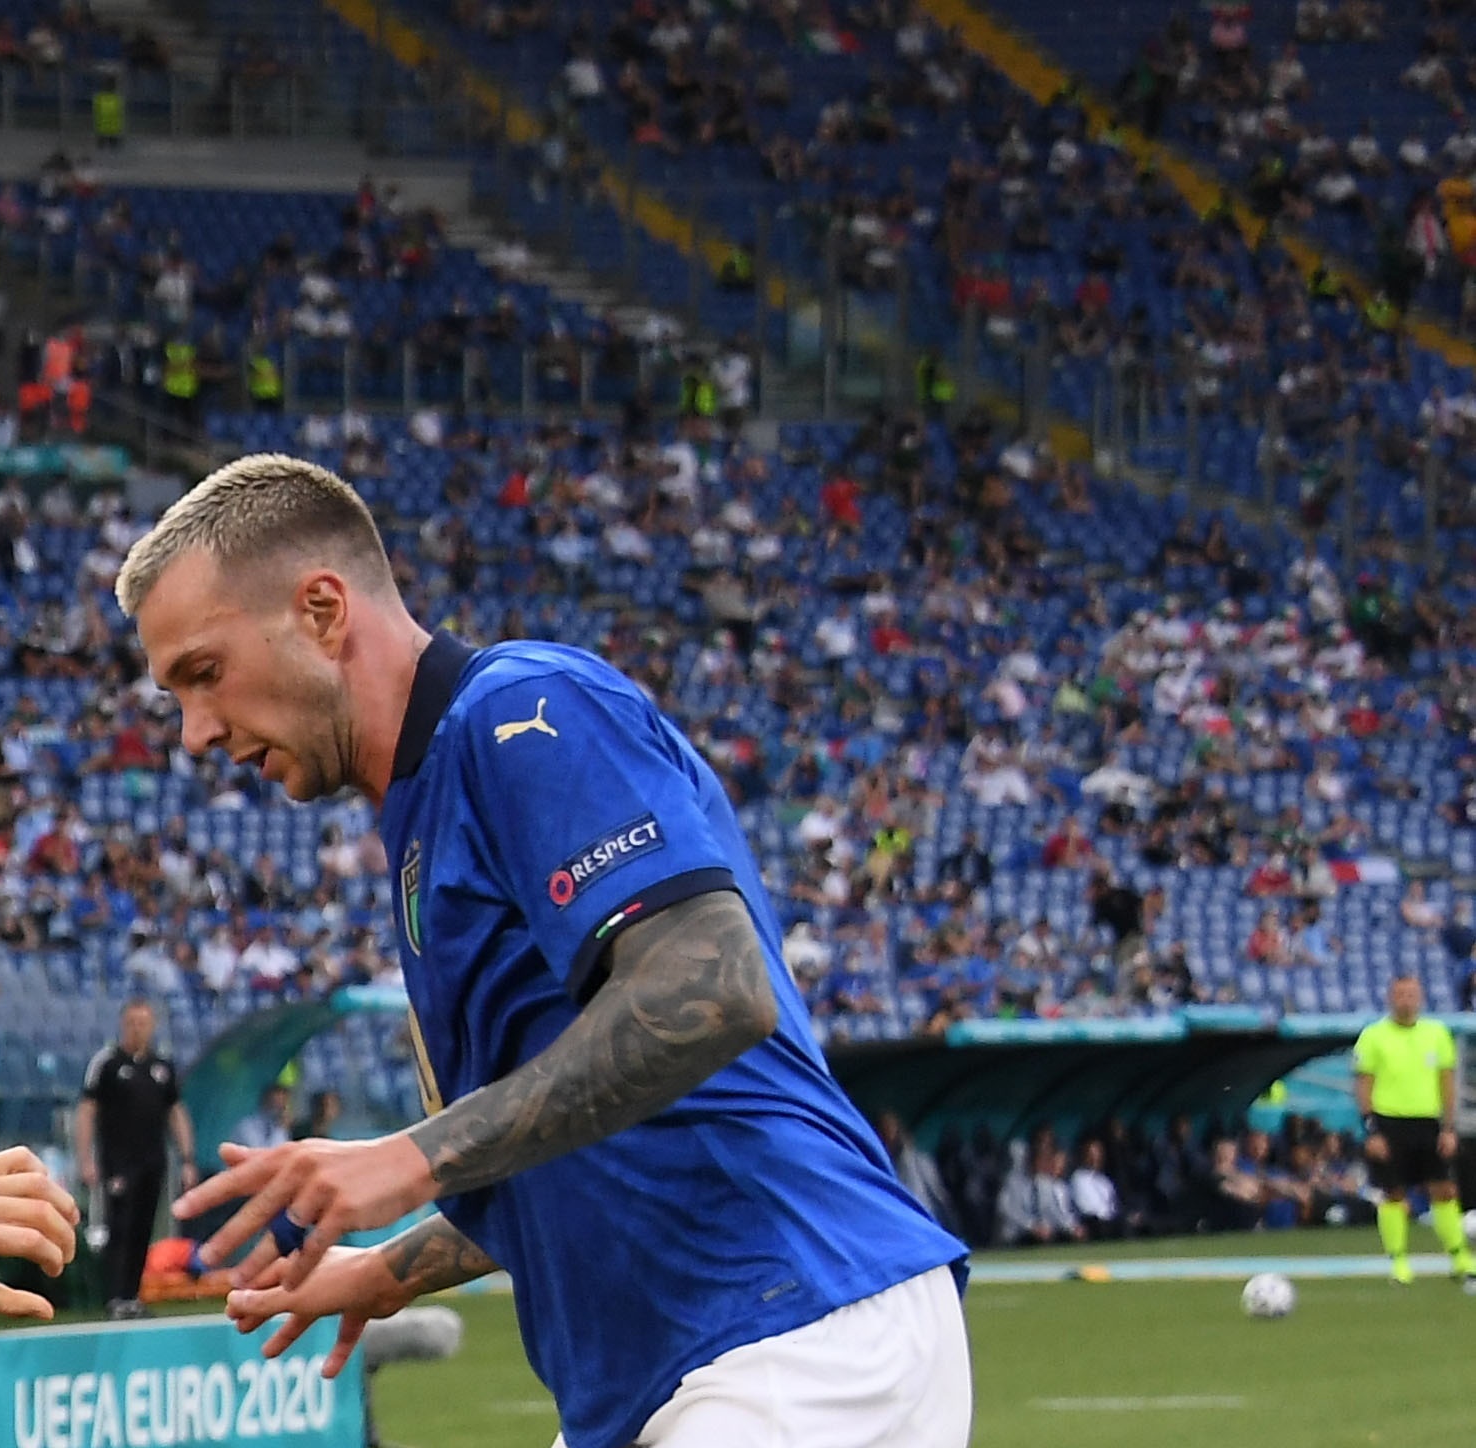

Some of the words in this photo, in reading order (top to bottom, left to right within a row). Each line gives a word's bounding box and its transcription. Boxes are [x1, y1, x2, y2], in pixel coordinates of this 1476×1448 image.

[571, 821, 658, 882] RESPECT
[124, 1363, 231, 1448] EURO
[237, 1353, 332, 1437] 2020
